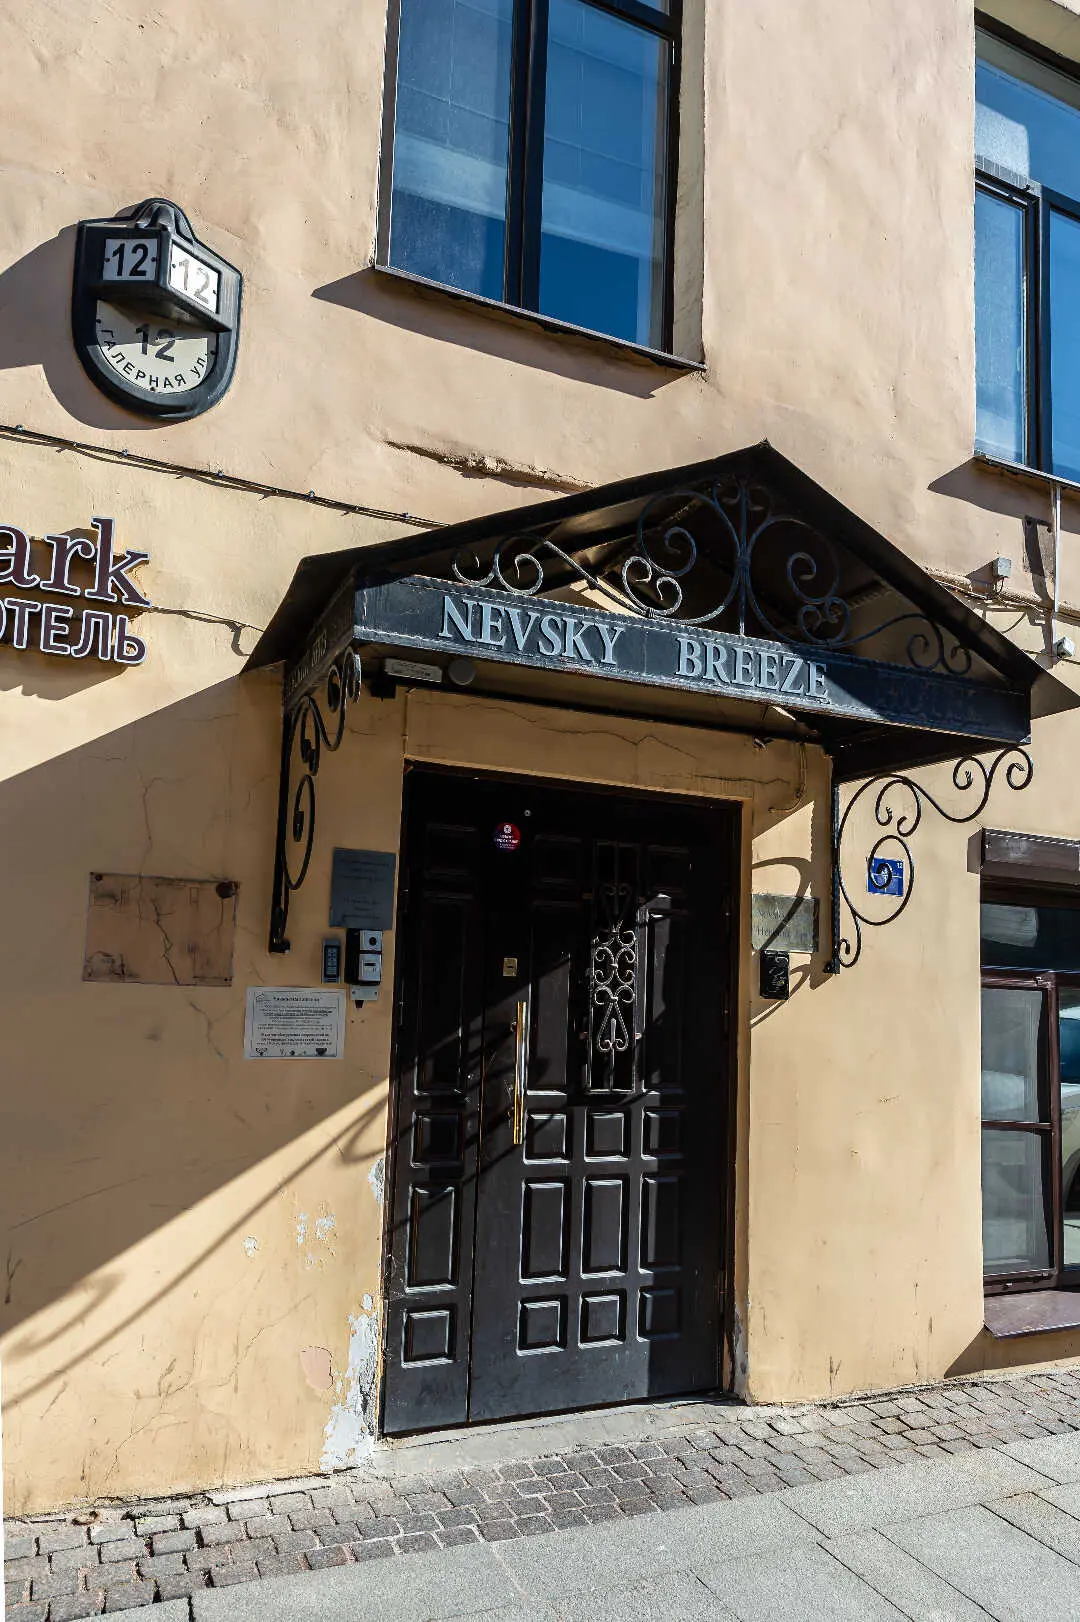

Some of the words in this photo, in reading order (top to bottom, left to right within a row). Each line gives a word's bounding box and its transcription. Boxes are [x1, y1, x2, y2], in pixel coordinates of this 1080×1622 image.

[112, 243, 149, 277] 12
[178, 258, 211, 305] 12
[101, 328, 187, 389] ГАЛЕРНАЯ
[135, 322, 175, 363] 12
[0, 597, 147, 665] ТЕЛЬ
[438, 595, 626, 666] NEVSKY
[675, 636, 830, 700] BREEZE
